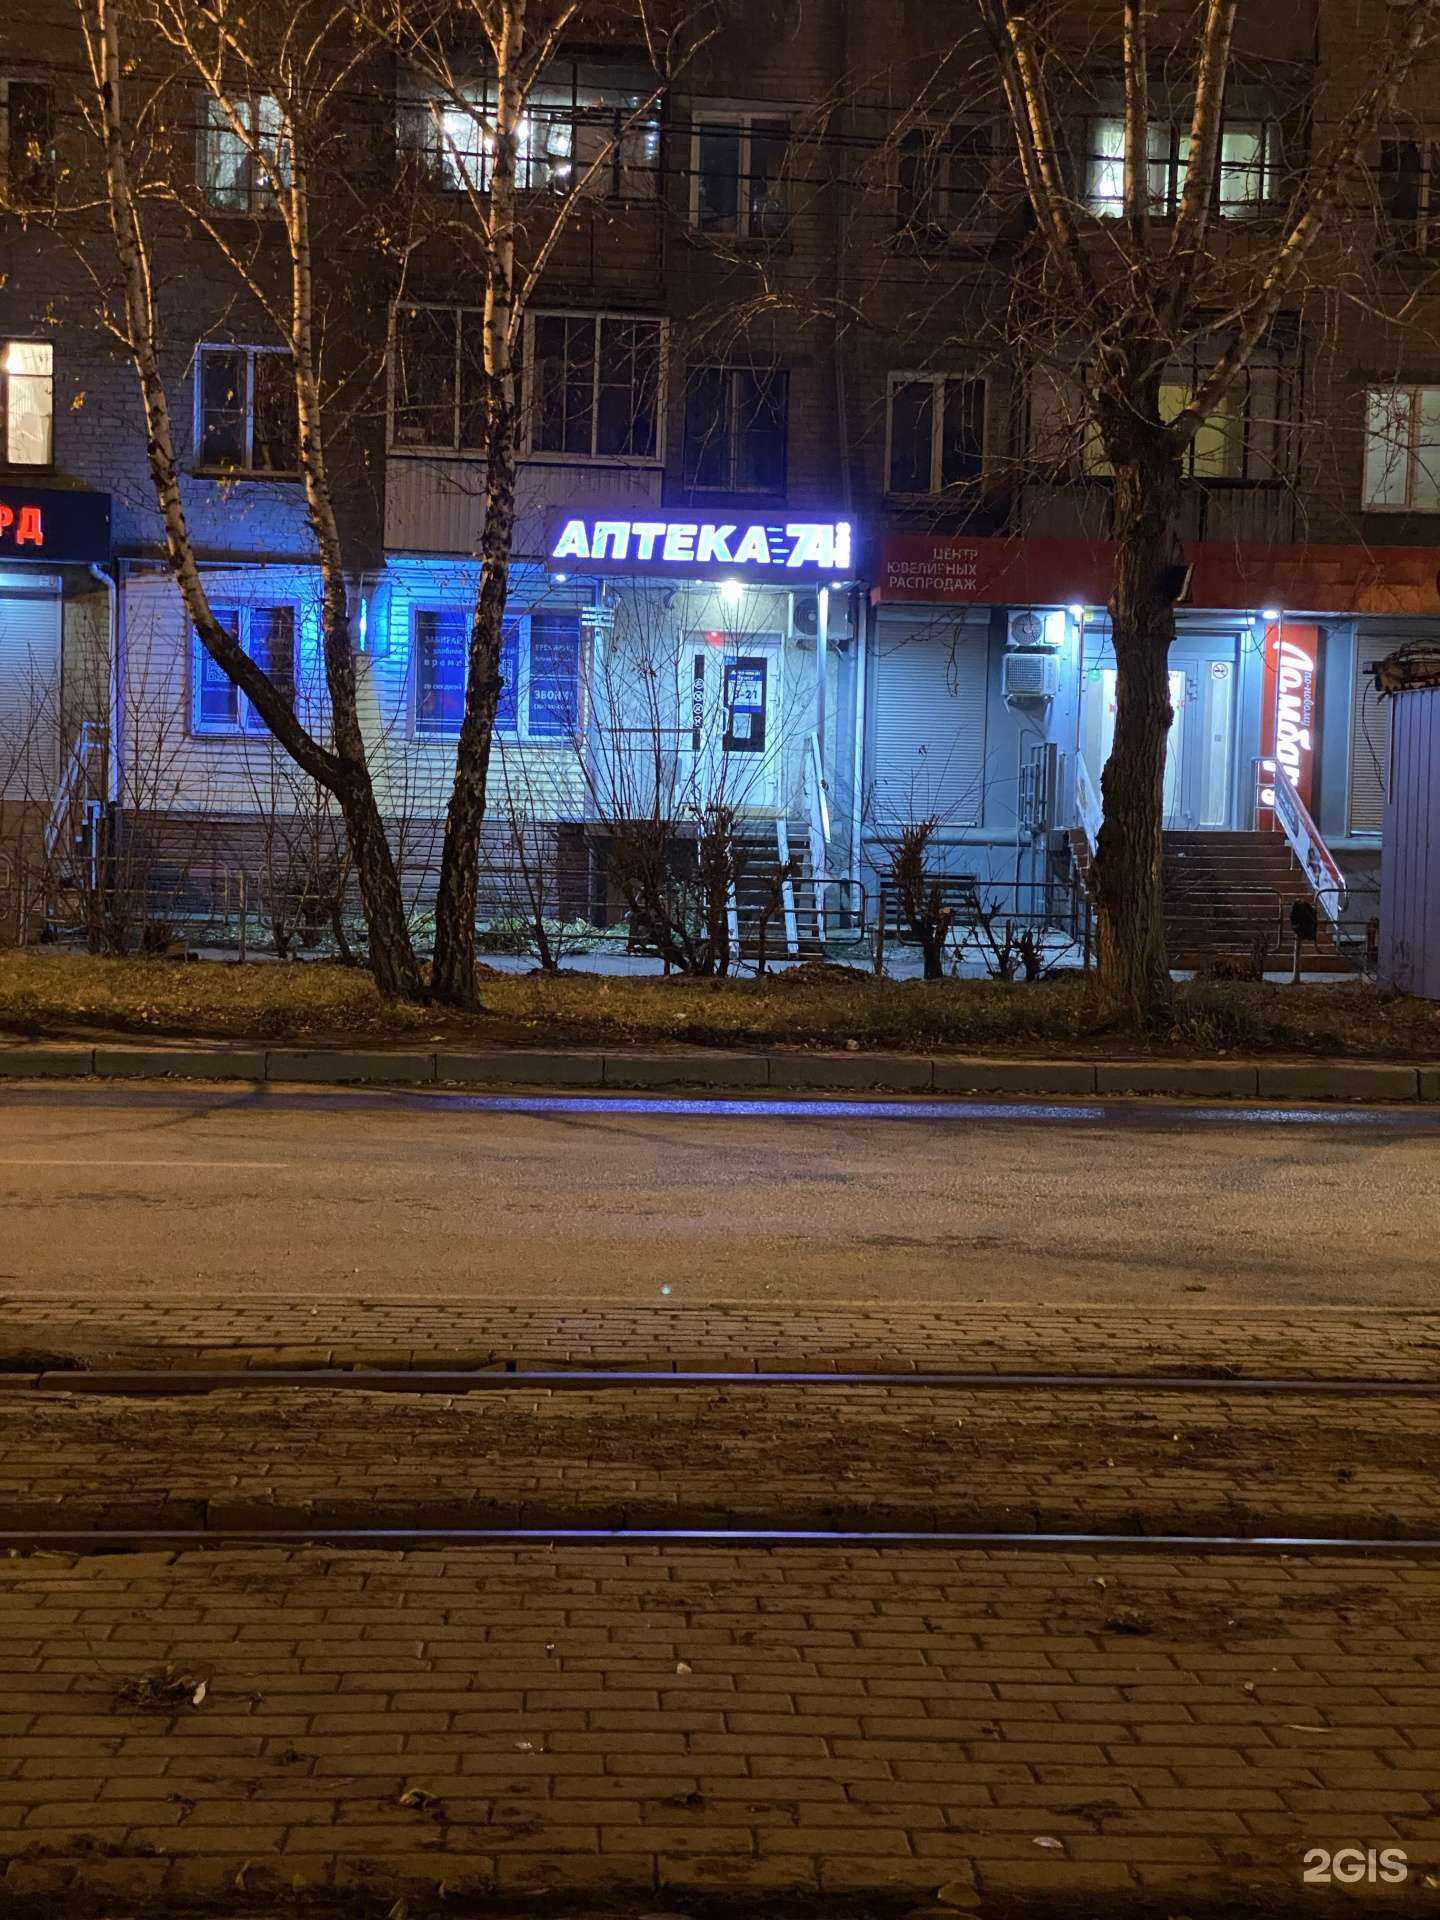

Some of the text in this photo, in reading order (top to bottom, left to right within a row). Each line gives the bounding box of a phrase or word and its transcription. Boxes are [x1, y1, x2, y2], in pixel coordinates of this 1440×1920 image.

[552, 520, 770, 563] АПТЕКА
[932, 547, 978, 562] ЦЕНТР
[889, 576, 977, 592] РАСПРОДАЖ
